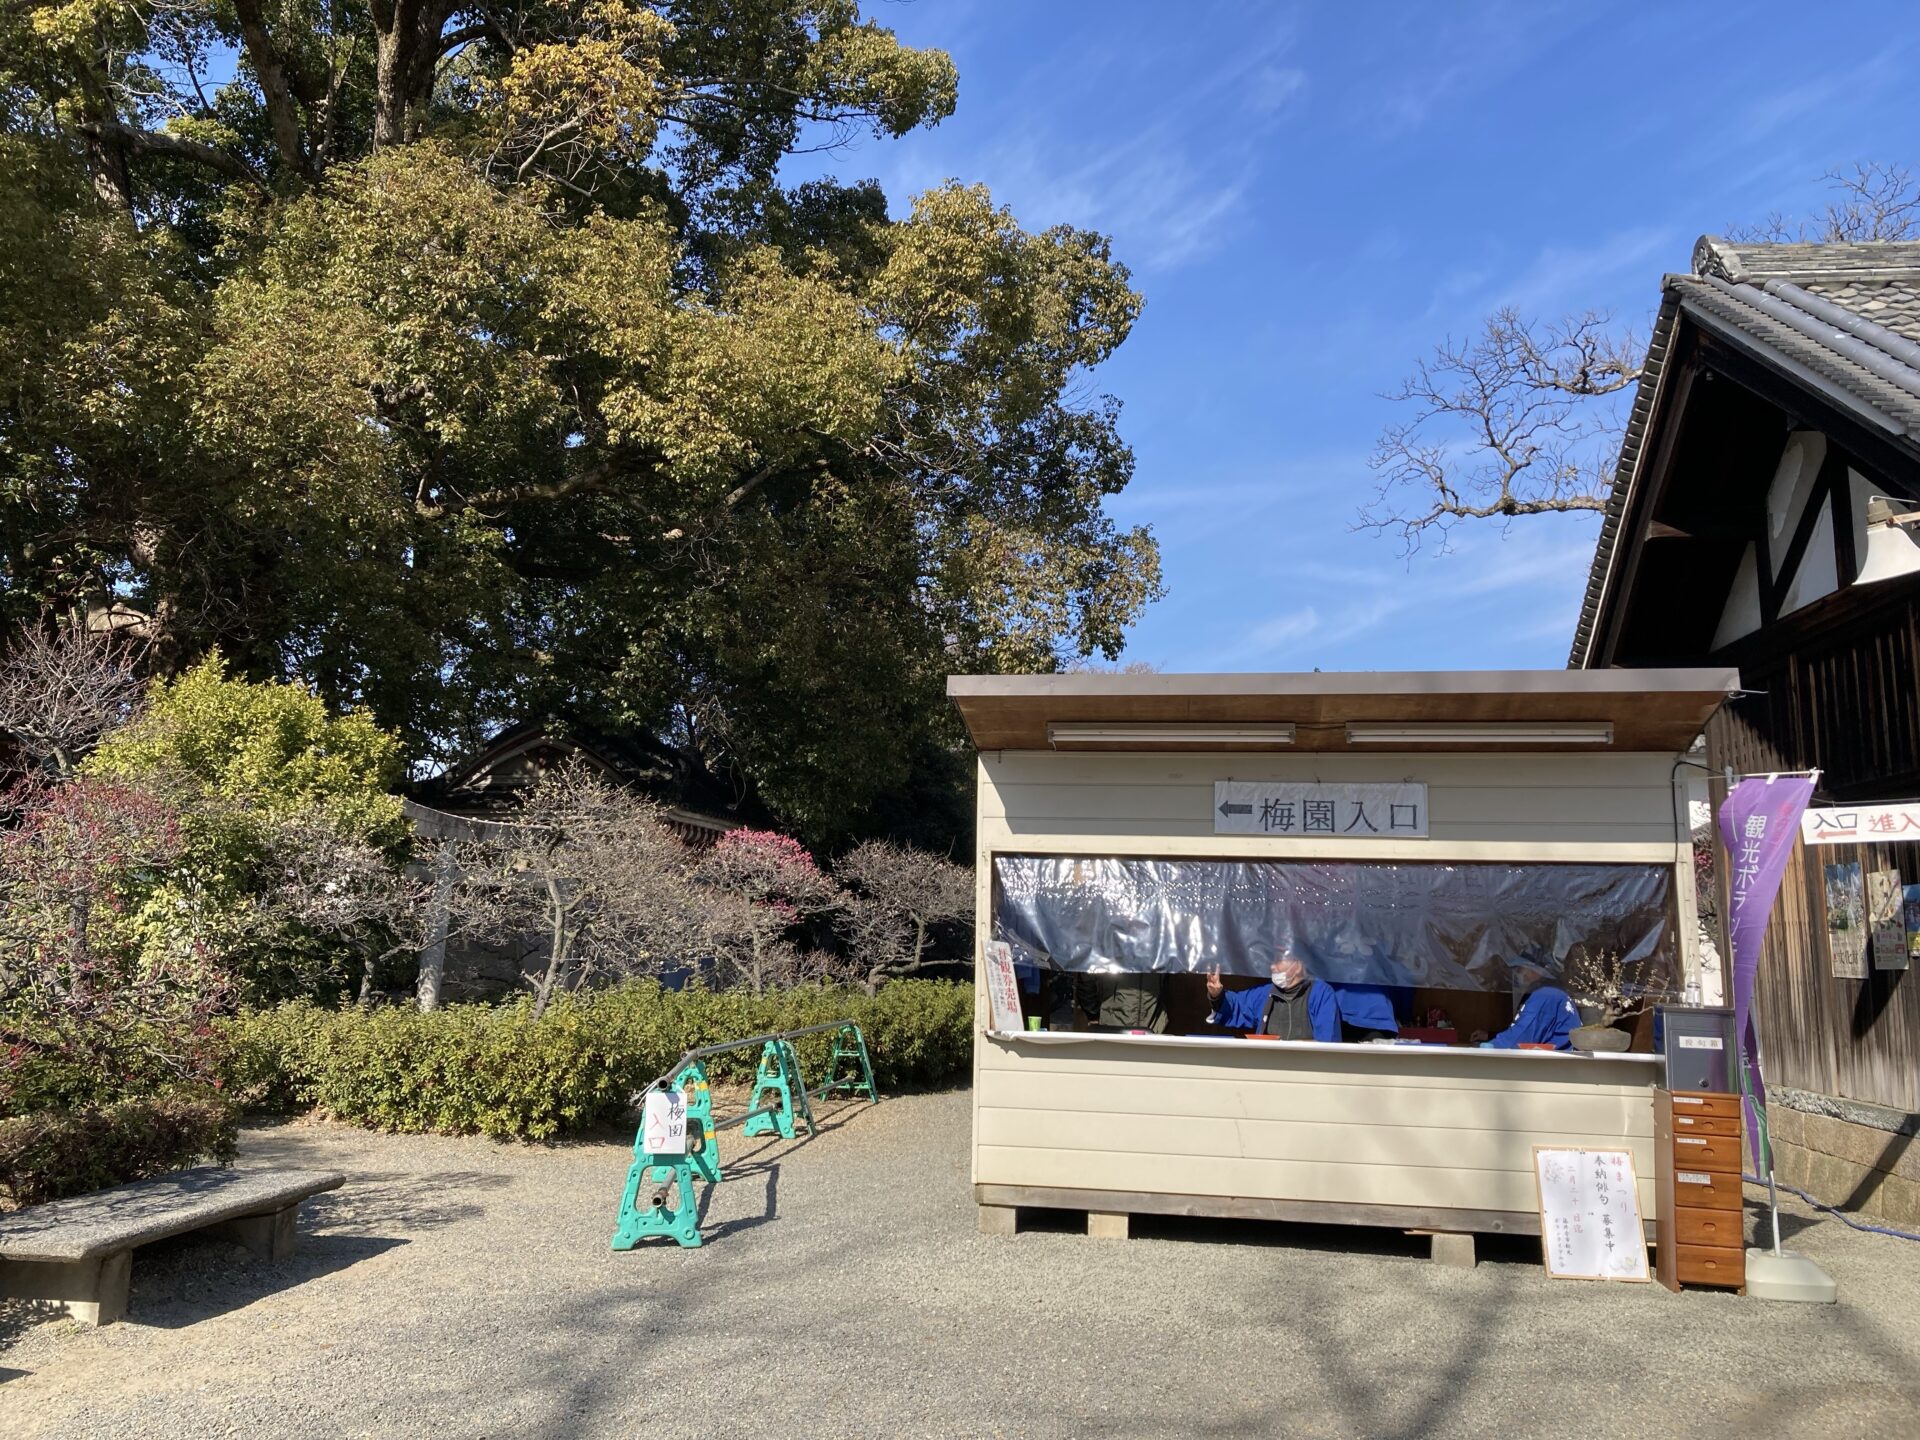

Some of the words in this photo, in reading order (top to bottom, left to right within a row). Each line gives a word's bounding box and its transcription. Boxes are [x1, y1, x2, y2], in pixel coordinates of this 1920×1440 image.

[1258, 797, 1418, 833] 梅園入口
[1813, 812, 1858, 829] 入口
[648, 1112, 666, 1149] 入口
[667, 1102, 685, 1138] 梅園
